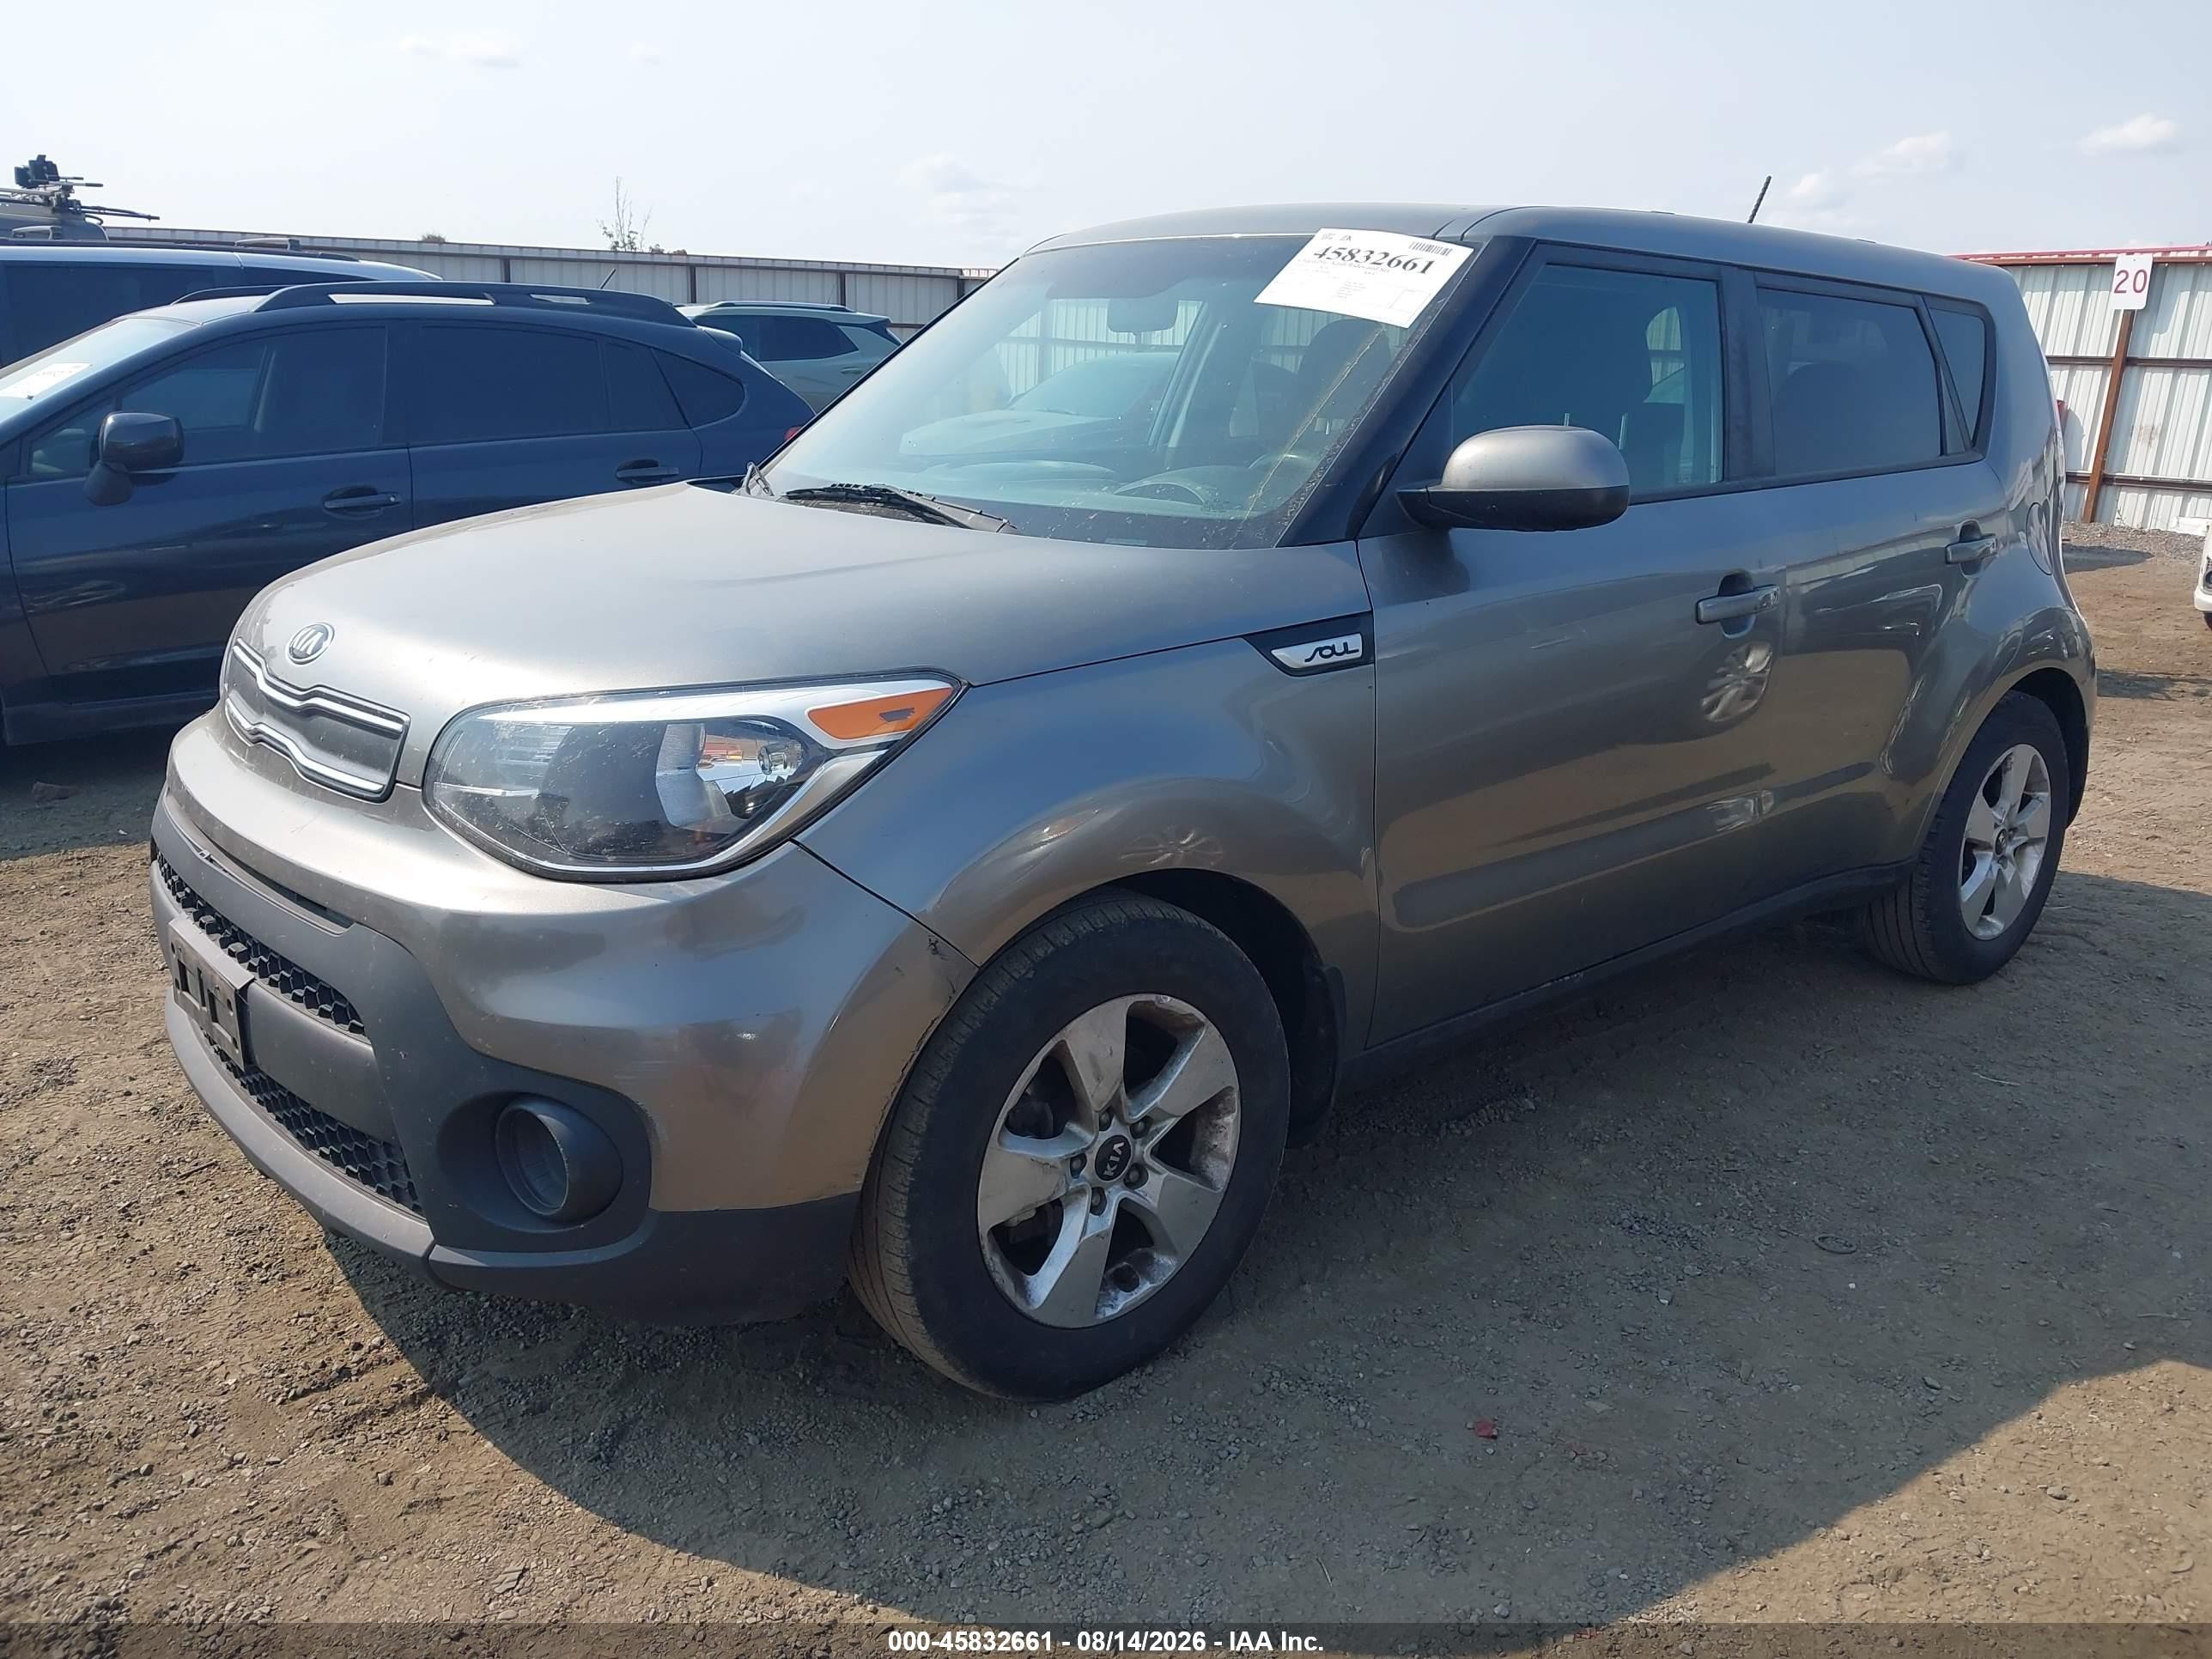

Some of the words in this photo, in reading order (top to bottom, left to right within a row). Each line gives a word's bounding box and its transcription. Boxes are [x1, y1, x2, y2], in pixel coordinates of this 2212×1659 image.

[1314, 246, 1436, 274] 45832661
[2113, 269, 2148, 294] 20
[1103, 1141, 1125, 1176] KIA
